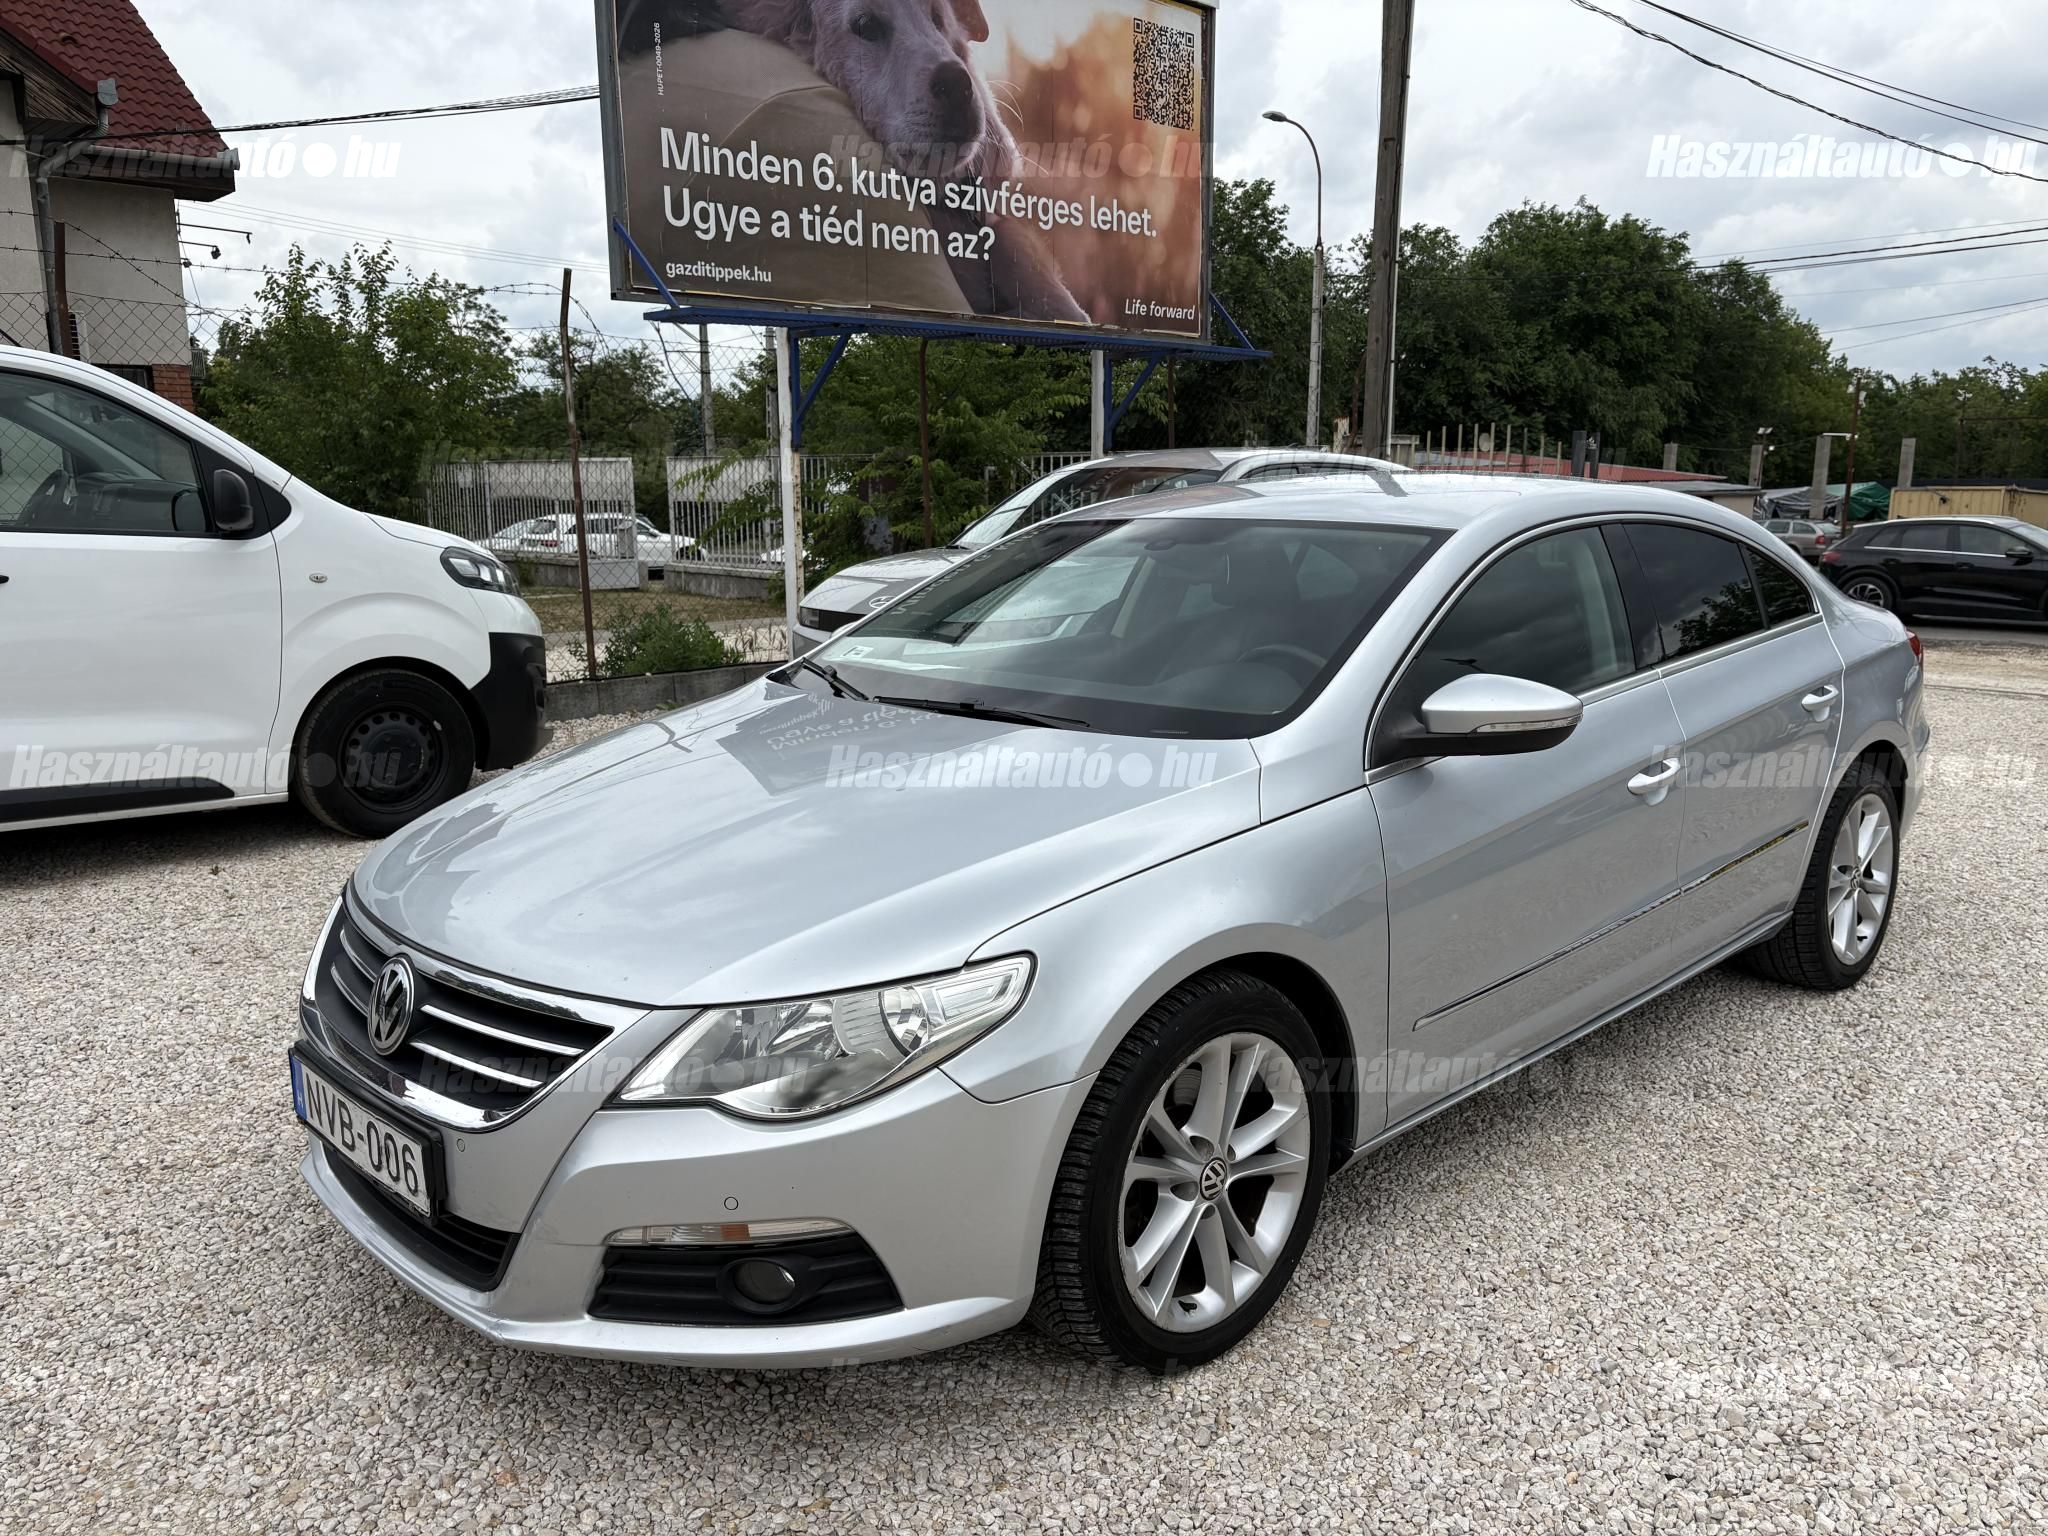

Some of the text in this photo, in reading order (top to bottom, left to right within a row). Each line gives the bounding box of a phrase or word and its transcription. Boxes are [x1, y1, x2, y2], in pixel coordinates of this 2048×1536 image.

[660, 126, 1157, 237] Minden 6. kutya szívférges lehet.
[663, 185, 996, 260] Ugye a tiéd nem az?
[665, 260, 772, 283] gazditippek.hu
[1125, 298, 1196, 320] Life forward
[305, 1072, 419, 1197] NVB-006
